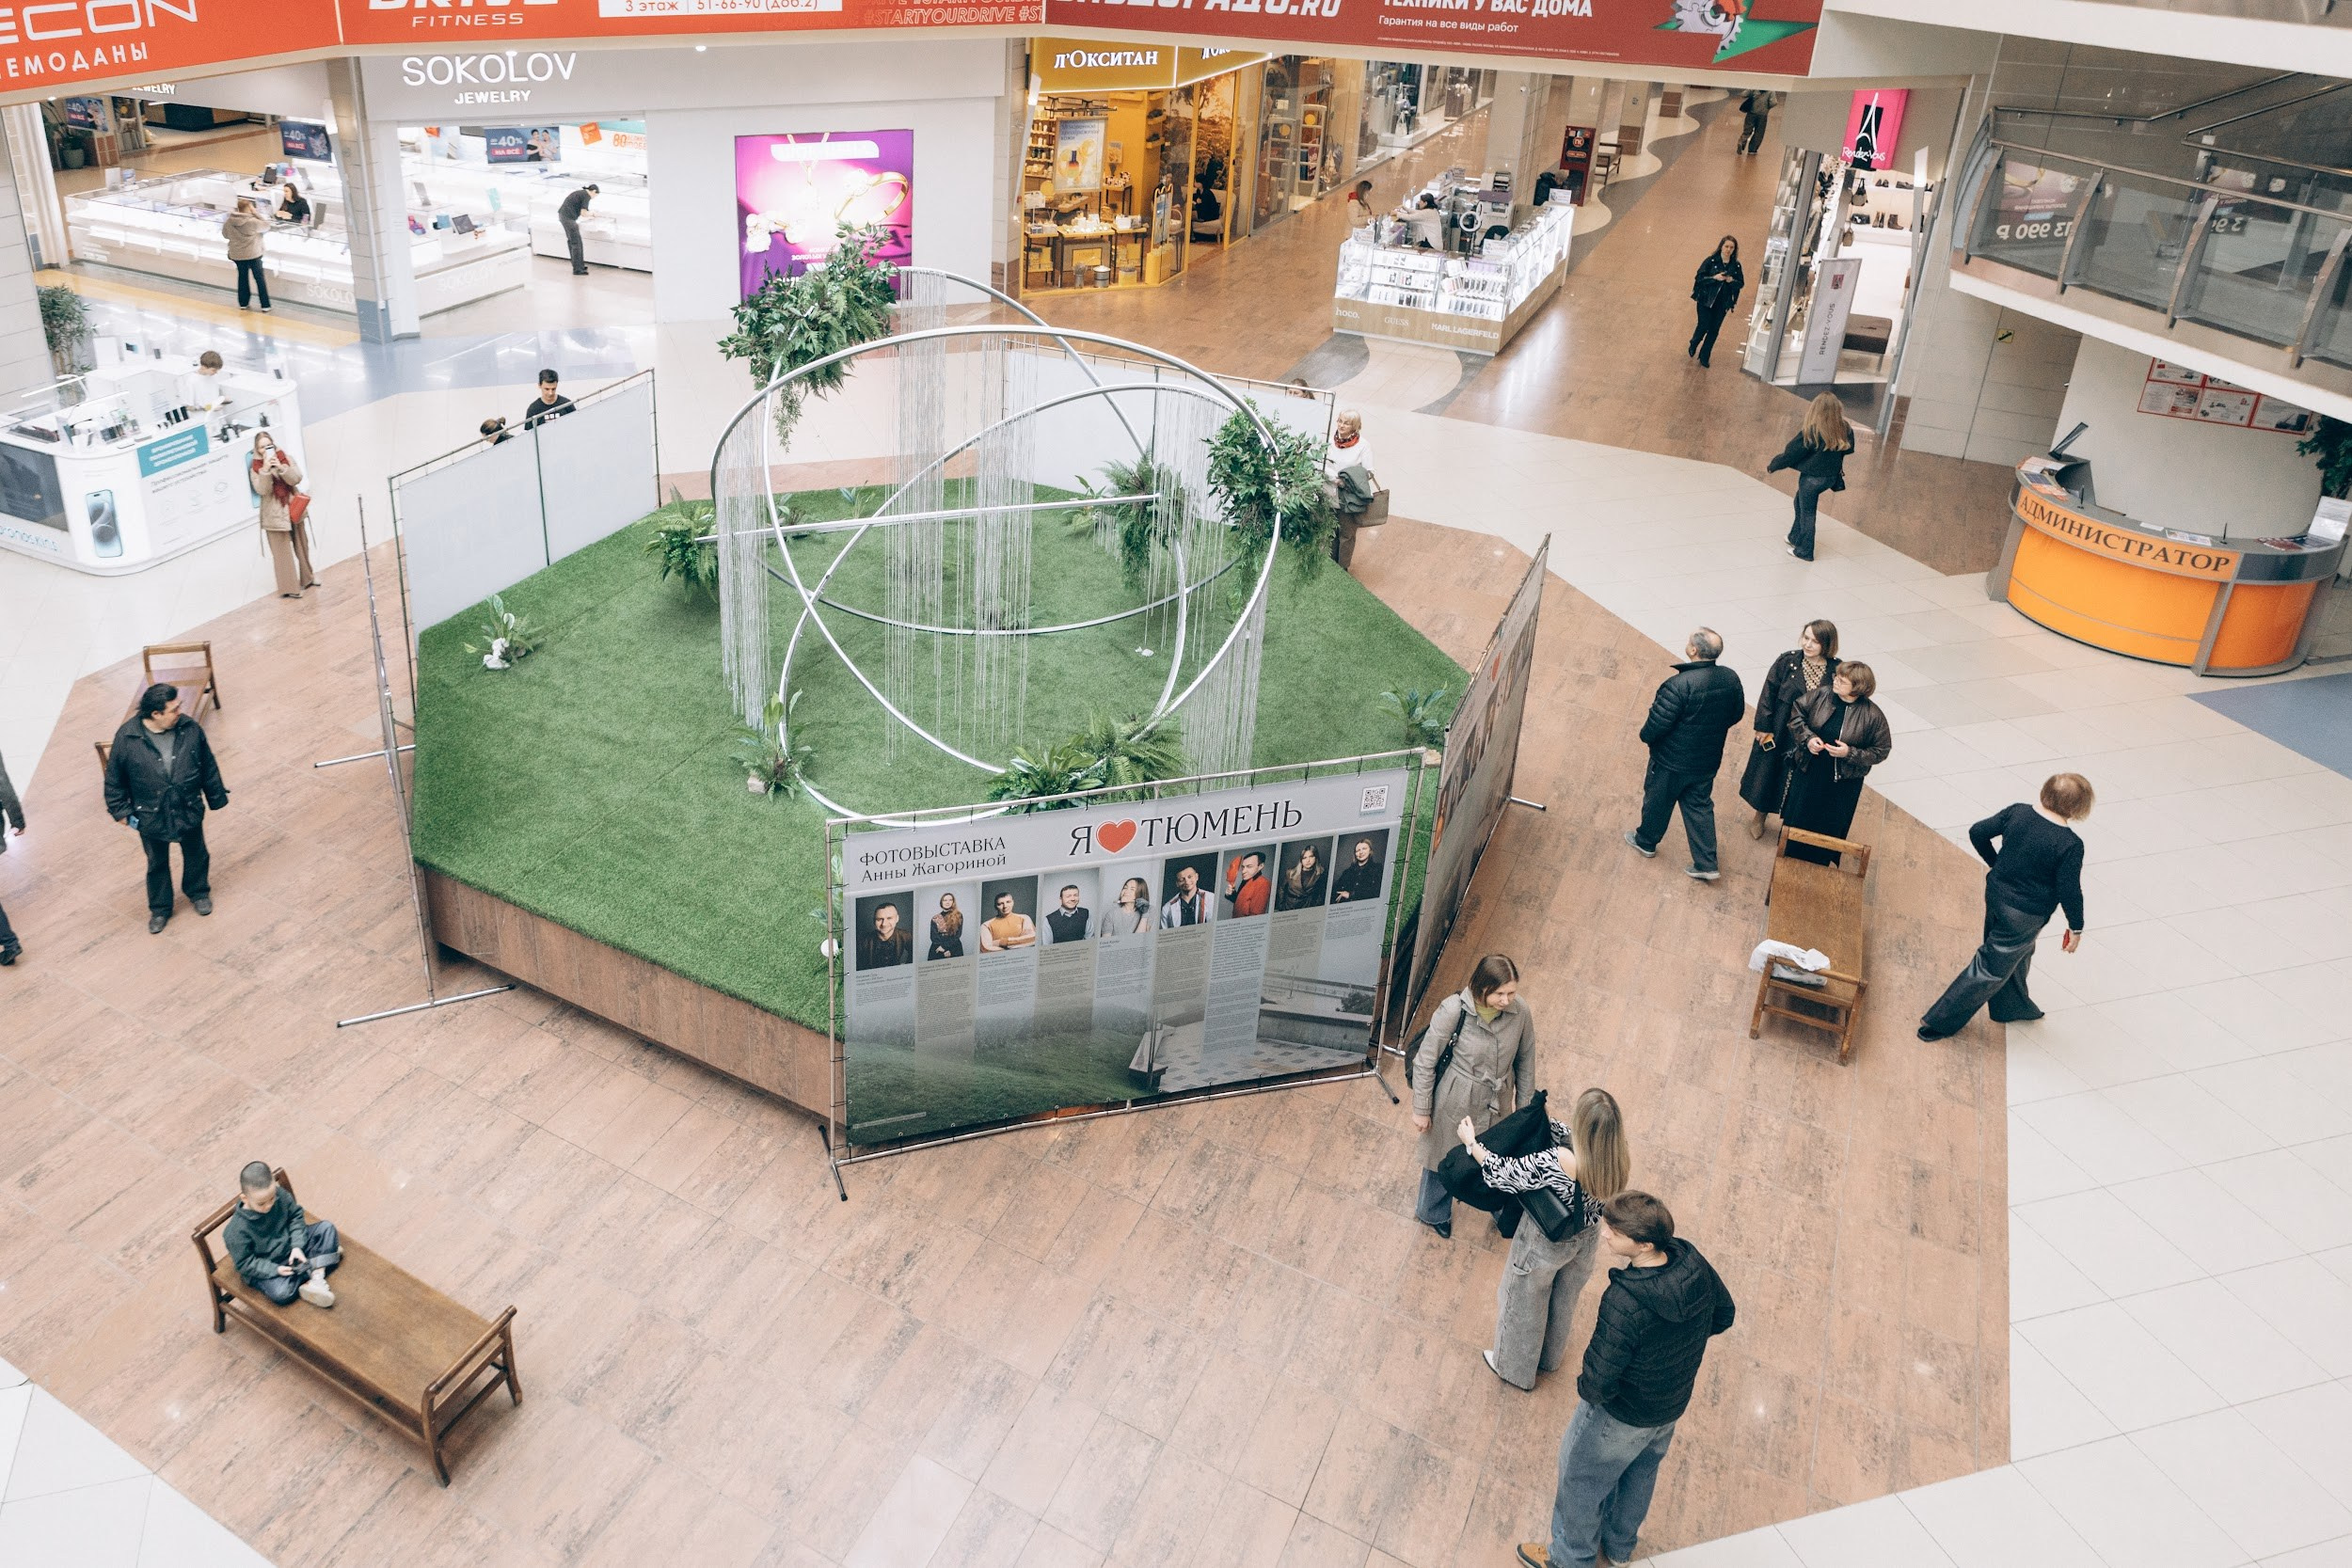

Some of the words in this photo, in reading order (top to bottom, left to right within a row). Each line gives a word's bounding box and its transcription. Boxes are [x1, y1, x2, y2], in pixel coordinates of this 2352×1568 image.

[639, 1, 678, 11] этаж
[1490, 0, 1528, 14] ВАС
[1532, 0, 1594, 18] ДОМА
[412, 13, 523, 28] FITNESS
[864, 7, 1015, 25] #STARTYOURDRIVE
[1378, 15, 1423, 28] Гарантия
[1425, 20, 1438, 28] на
[1439, 21, 1457, 30] все
[1459, 23, 1486, 32] виды
[1487, 23, 1519, 34] работ
[0, 41, 148, 79] ЕМОДАНЫ
[402, 51, 577, 87] SOKOLOV
[132, 83, 177, 95] WELRY
[454, 89, 532, 105] JEWELRY
[1841, 146, 1886, 162] Rendez-Vous
[1335, 307, 1360, 320] hoco.
[1384, 316, 1409, 326] GUESS
[1431, 323, 1453, 333] KARL
[1453, 326, 1500, 340] LAGERFELD
[1819, 303, 1836, 356] RENDEZ-VOUS
[2020, 495, 2231, 573] АДМИНИСТРАТОР
[1069, 825, 1092, 856] Я
[1140, 800, 1303, 847] ТЮМЕНЬ
[860, 836, 1006, 866] ФОТОВЫСТАВКА
[862, 868, 907, 882] Анны
[912, 853, 1007, 876] Жагориной
